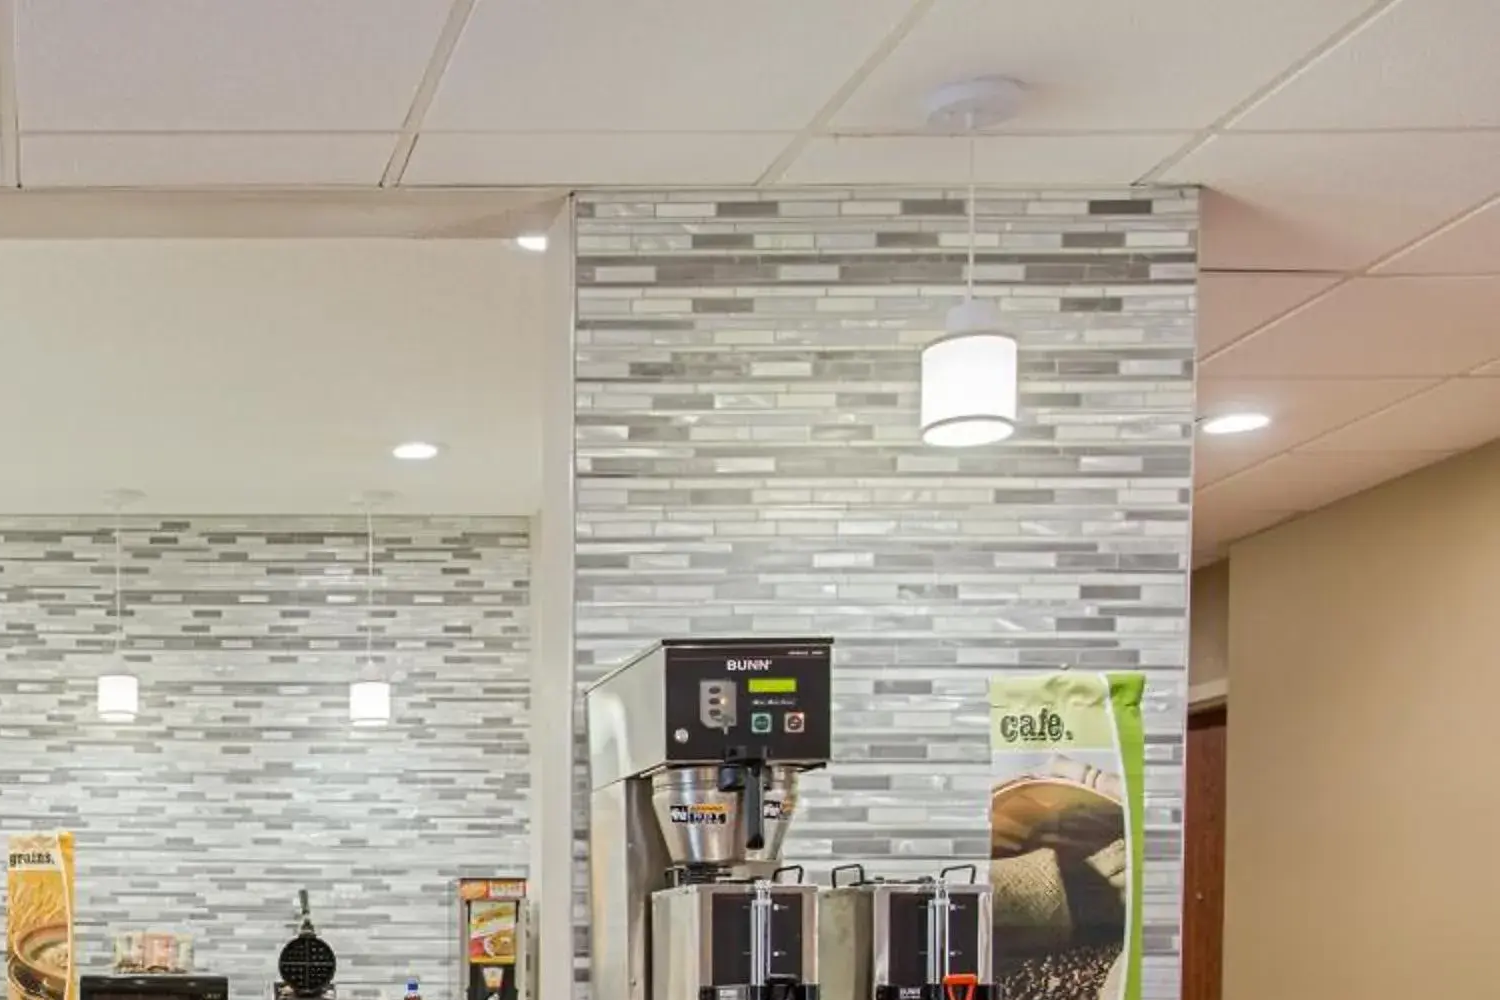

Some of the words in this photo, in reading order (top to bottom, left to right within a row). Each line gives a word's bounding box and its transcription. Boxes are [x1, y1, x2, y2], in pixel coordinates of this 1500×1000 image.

[726, 659, 769, 671] BUNN
[1000, 708, 1074, 743] cafe.
[9, 852, 56, 868] grains.
